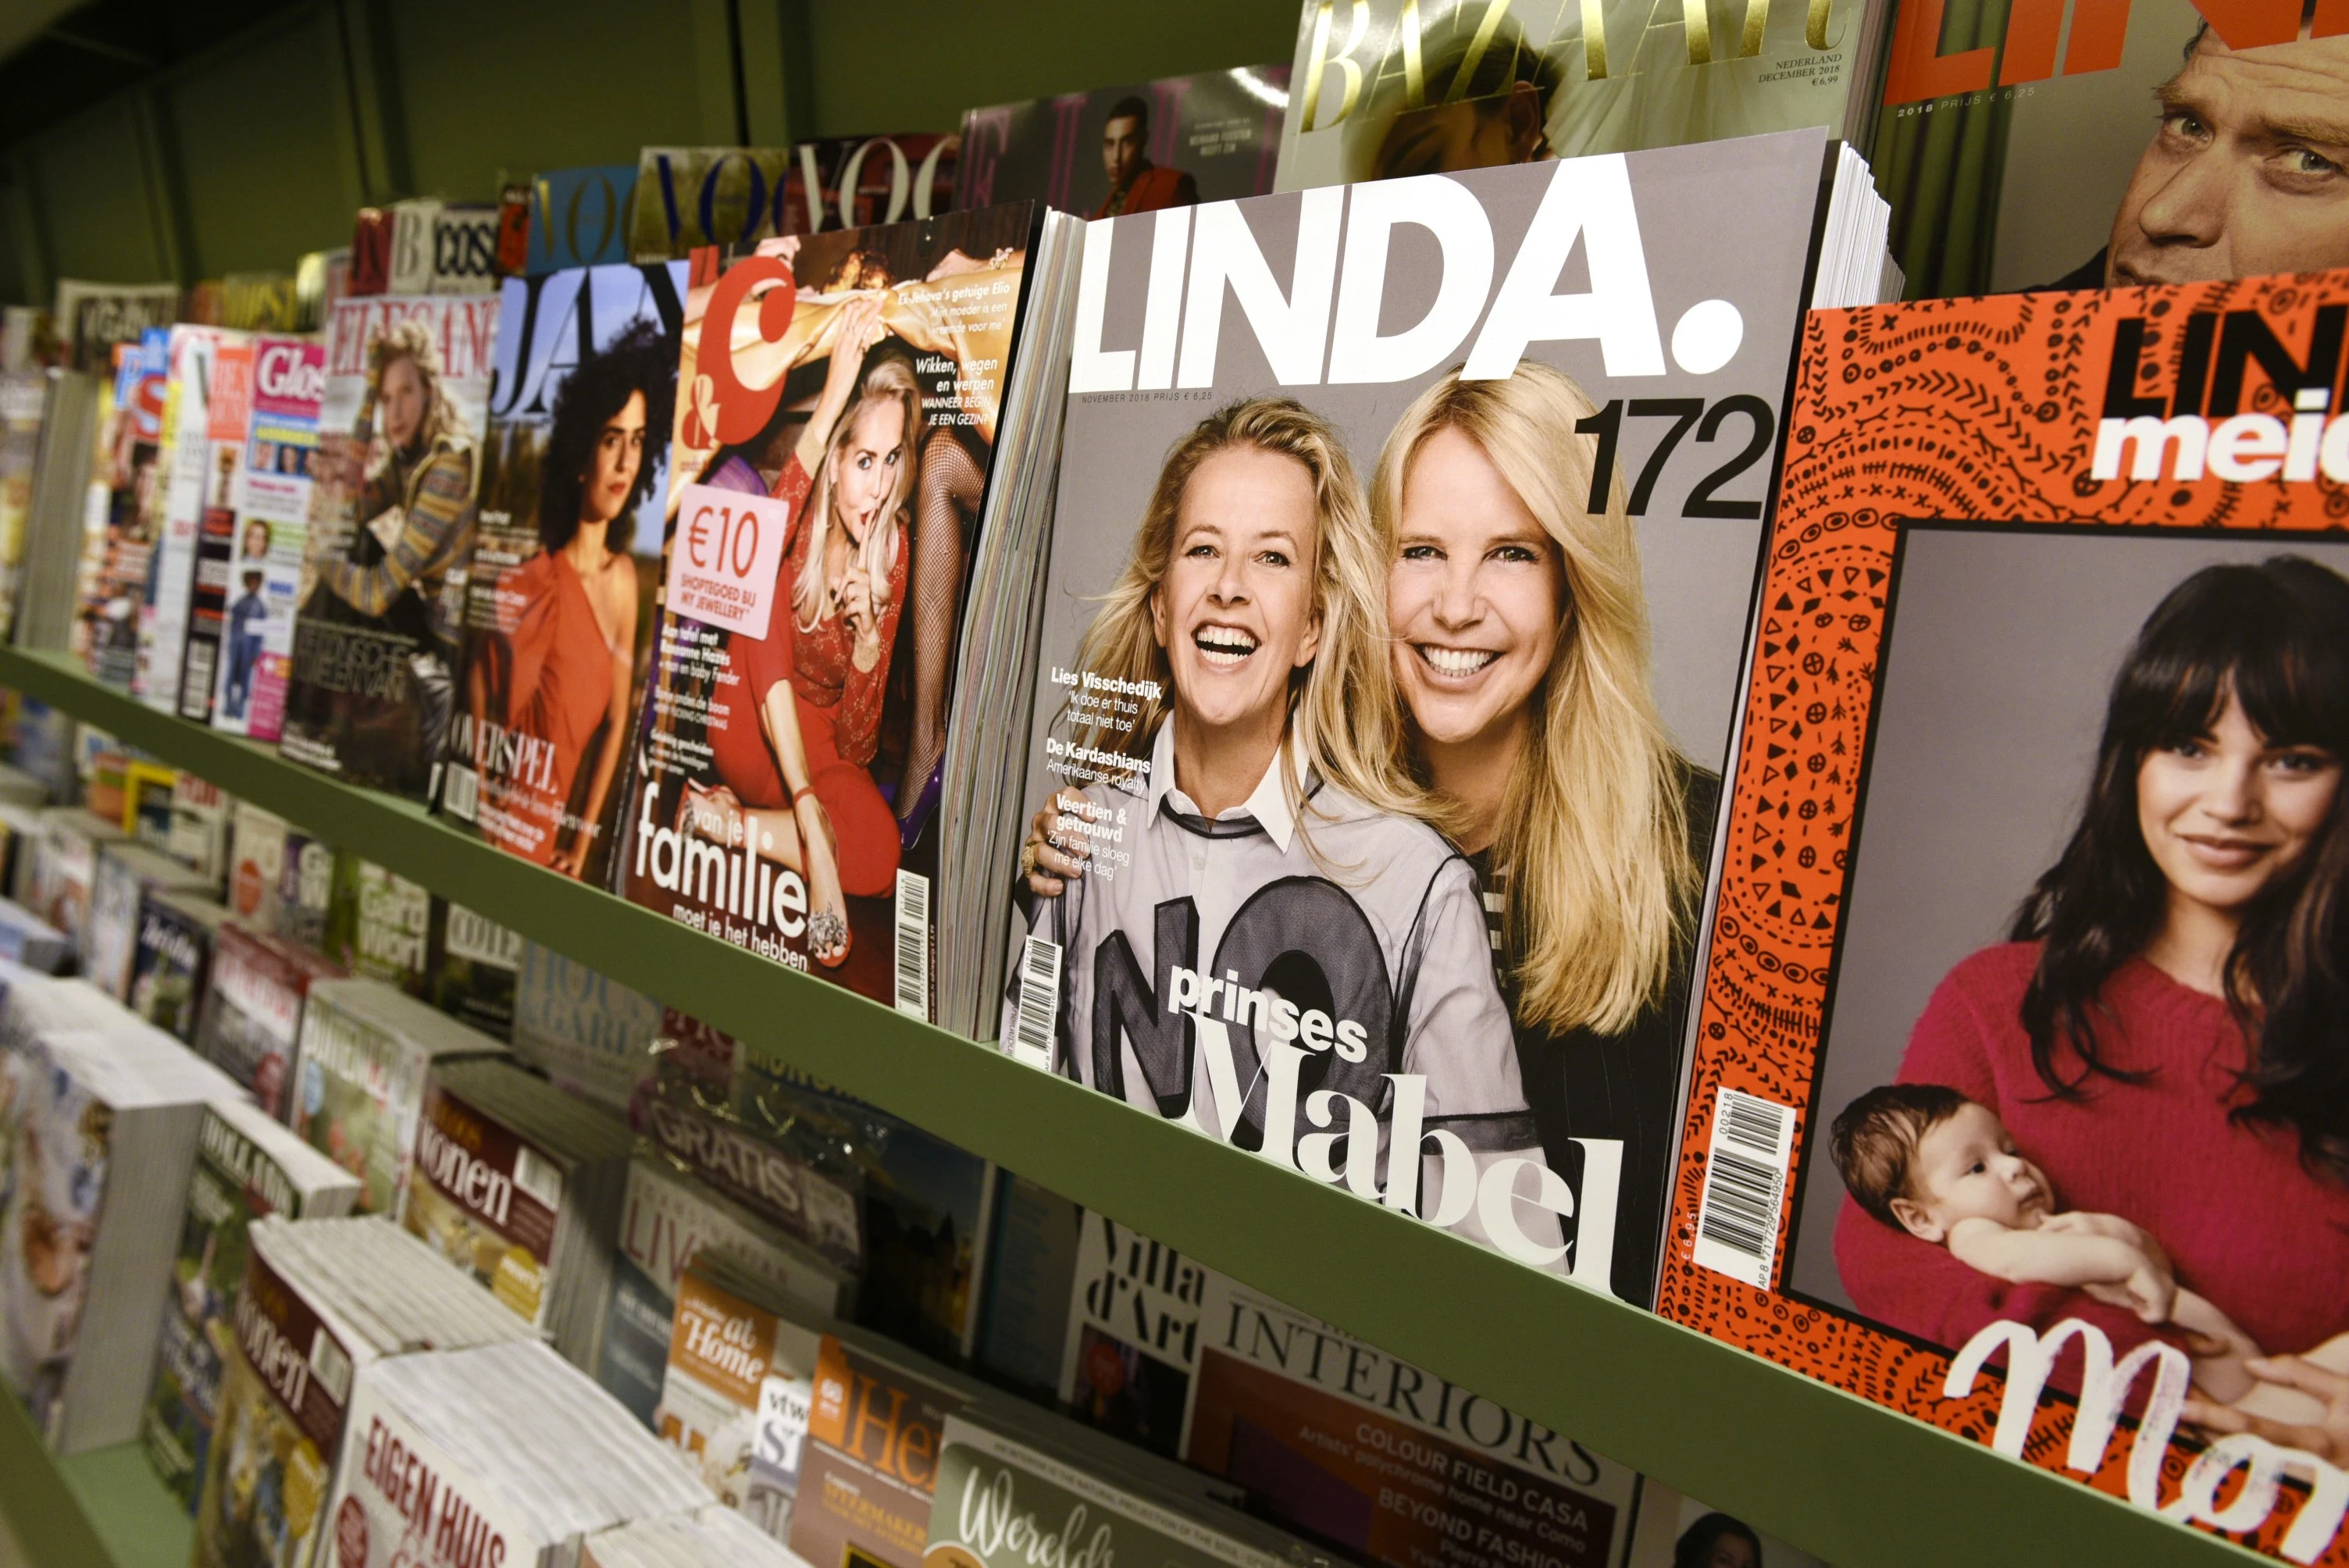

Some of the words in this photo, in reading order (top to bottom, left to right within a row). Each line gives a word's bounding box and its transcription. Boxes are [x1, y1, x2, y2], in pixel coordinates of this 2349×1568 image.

[1759, 68, 1815, 83] DECEMBER
[1819, 65, 1840, 75] 2018
[1775, 54, 1842, 69] NEDERLAND
[1898, 104, 1934, 117] 2018
[1941, 96, 1980, 109] PRIJS
[656, 154, 787, 245] VO
[1068, 152, 1744, 394] LINDA.
[952, 285, 988, 301] getuige
[992, 281, 1011, 295] Elio
[950, 302, 981, 316] moeder
[983, 302, 989, 313] is
[991, 303, 1007, 312] een
[968, 321, 986, 333] voor
[916, 356, 957, 375] Wikken,
[961, 358, 997, 375] wegen
[2103, 305, 2349, 418] LIN
[921, 397, 963, 409] WANNEER
[964, 396, 991, 408] BEGIN
[936, 380, 950, 392] en
[953, 379, 994, 395] werpen
[1082, 394, 1125, 403] NOVEMBER
[1129, 393, 1150, 401] 2018
[1154, 392, 1178, 401] PRIJS
[1193, 391, 1212, 401] 6,25
[928, 414, 938, 426] JE
[939, 414, 955, 425] EEN
[957, 413, 989, 426] GEZIN?
[1574, 395, 1775, 519] 172
[681, 573, 740, 601] SHOPTEGOED
[743, 589, 757, 608] BIJ
[681, 592, 694, 606] MY
[679, 626, 700, 643] tafel
[700, 632, 718, 646] met
[712, 665, 740, 686] Fender
[1051, 667, 1078, 686] Lies
[1082, 672, 1162, 701] Visschedijk
[708, 697, 730, 716] boom
[1068, 709, 1093, 725] totaal
[1096, 716, 1114, 729] niet
[1081, 693, 1099, 707] doe
[1101, 698, 1112, 709] er
[1114, 698, 1138, 715] thuis
[1046, 737, 1064, 755] De
[1065, 742, 1151, 773] Kardashians
[1046, 758, 1109, 784] Amerikaanse
[1111, 775, 1146, 795] royalty
[1057, 793, 1113, 821] Veertien
[1117, 808, 1127, 825] &
[693, 805, 722, 835] van
[727, 809, 743, 849] je
[1057, 815, 1123, 843] getrouwd
[635, 781, 807, 938] familie
[1054, 853, 1069, 865] me
[1072, 857, 1092, 871] elke
[1069, 836, 1100, 855] familie
[1103, 846, 1130, 867] sloeg
[673, 903, 706, 929] moet
[708, 911, 722, 938] je
[725, 916, 748, 946] het
[751, 925, 808, 973] hebben
[1167, 965, 1367, 1064] prinses
[1045, 1062, 1050, 1071] AP
[1719, 1092, 1734, 1135] 00218
[650, 1100, 800, 1213] GRATIS
[1170, 1007, 1626, 1303] Mabel
[1769, 1172, 1784, 1213] 564950
[1762, 1216, 1777, 1256] 717729
[1759, 1274, 1767, 1288] AP
[1760, 1264, 1770, 1273] 8
[680, 1310, 765, 1384] Home
[723, 1316, 756, 1351] at
[1225, 1301, 1601, 1487] INTERIORS
[847, 1373, 942, 1493] He
[363, 1413, 438, 1538] EIGEN
[1356, 1423, 1449, 1474] COLOUR
[1453, 1459, 1518, 1502] FIELD
[1522, 1489, 1589, 1533] CASA
[1354, 1449, 1445, 1497] polychrome
[1448, 1485, 1494, 1516] home
[1495, 1501, 1534, 1532] near
[1537, 1522, 1588, 1555] Como
[1378, 1487, 1474, 1542] BEYOND
